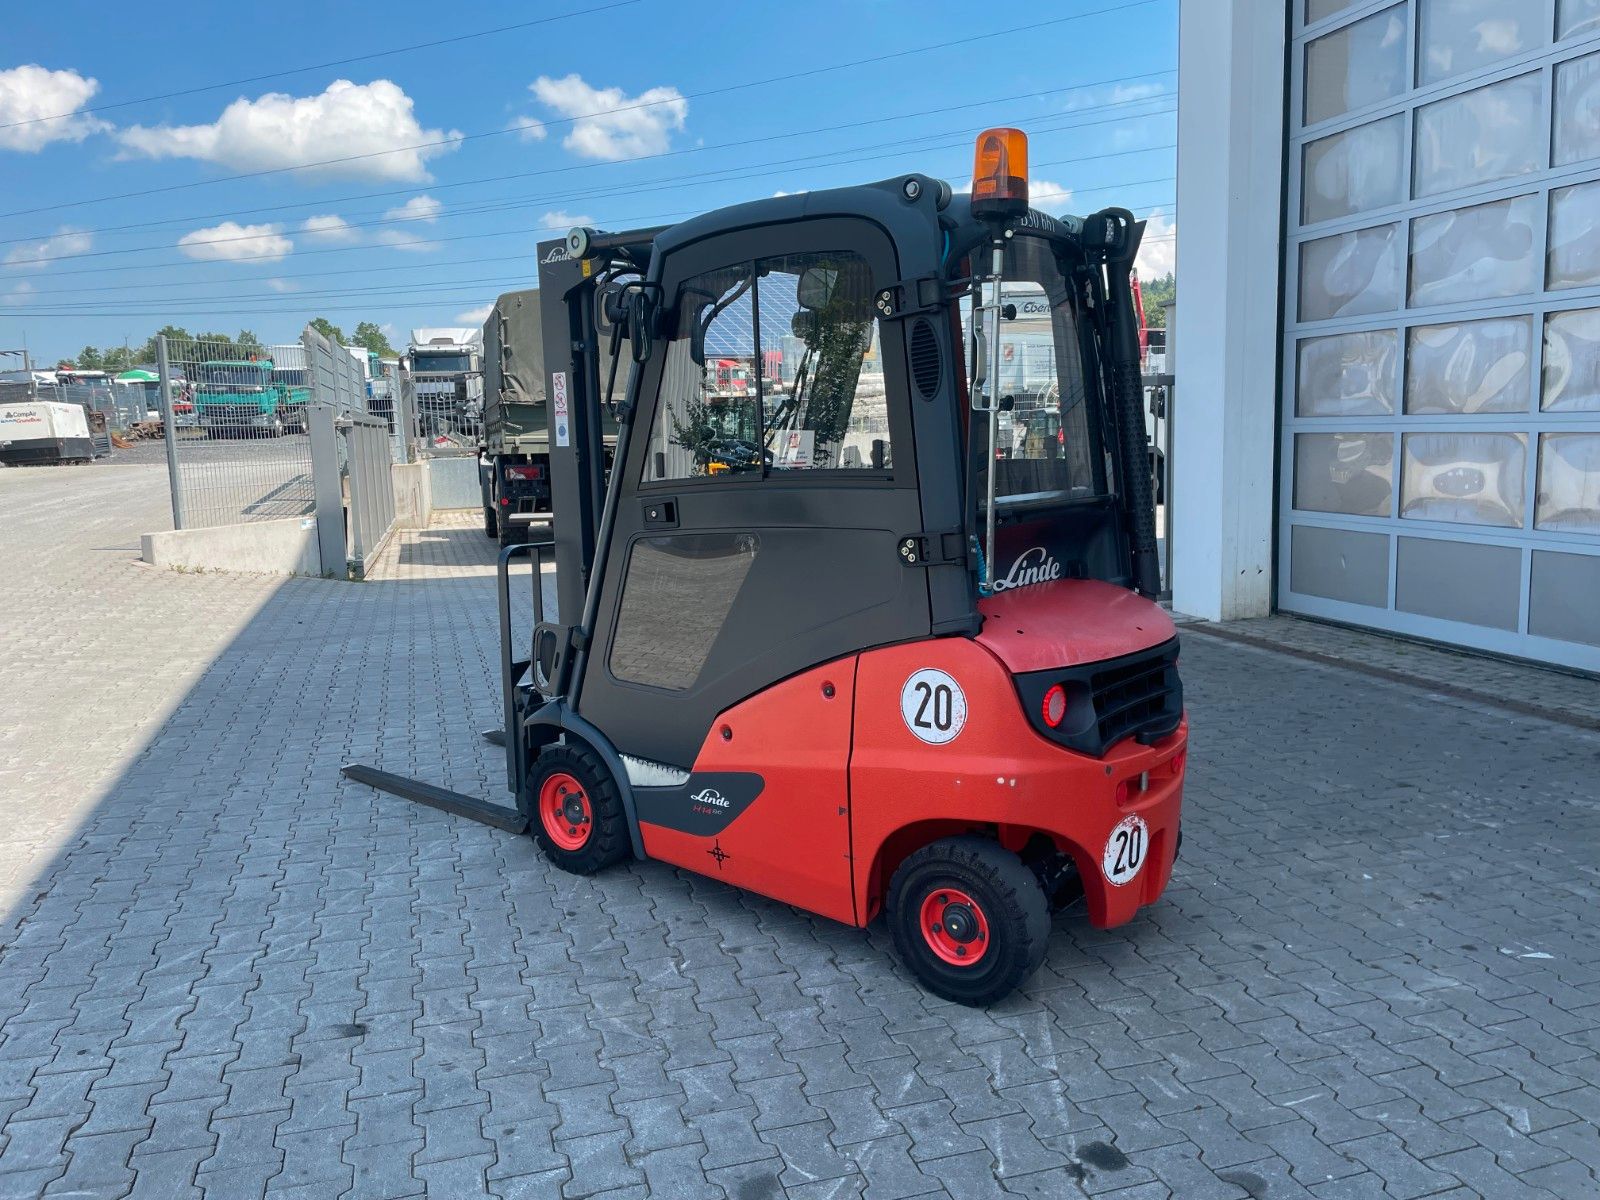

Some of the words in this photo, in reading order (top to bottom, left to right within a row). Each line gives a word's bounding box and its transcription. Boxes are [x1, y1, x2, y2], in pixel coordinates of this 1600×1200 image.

[992, 546, 1062, 592] Linde
[914, 681, 952, 732] 20
[690, 788, 731, 808] Linde
[1113, 825, 1142, 876] 20
